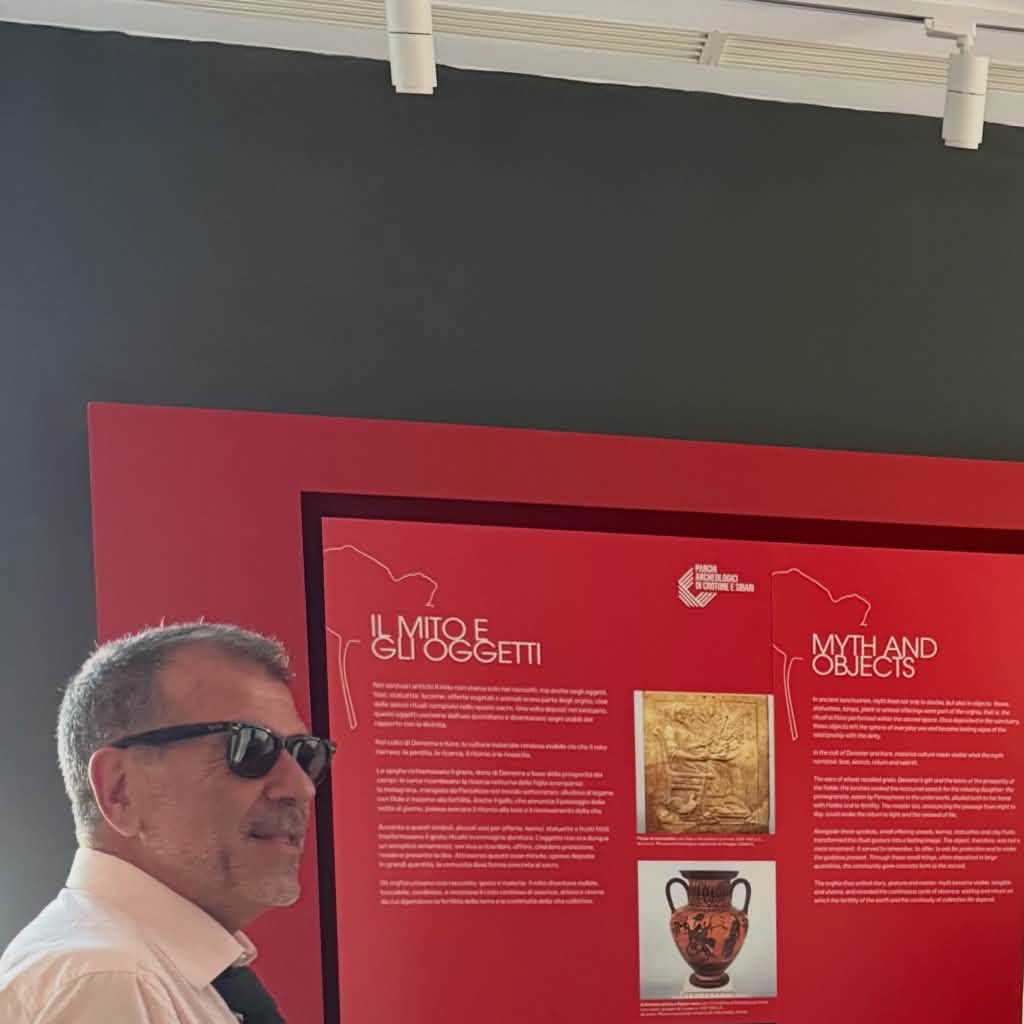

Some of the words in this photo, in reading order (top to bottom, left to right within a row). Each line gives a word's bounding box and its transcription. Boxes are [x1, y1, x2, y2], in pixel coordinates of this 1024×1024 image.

[370, 614, 392, 638] IL
[398, 616, 466, 640] MITO
[475, 618, 489, 641] E
[371, 637, 415, 660] GLI
[424, 639, 541, 664] OGGETTI
[812, 633, 877, 657] MYTH
[884, 635, 938, 659] AND
[812, 654, 916, 678] OBJECTS
